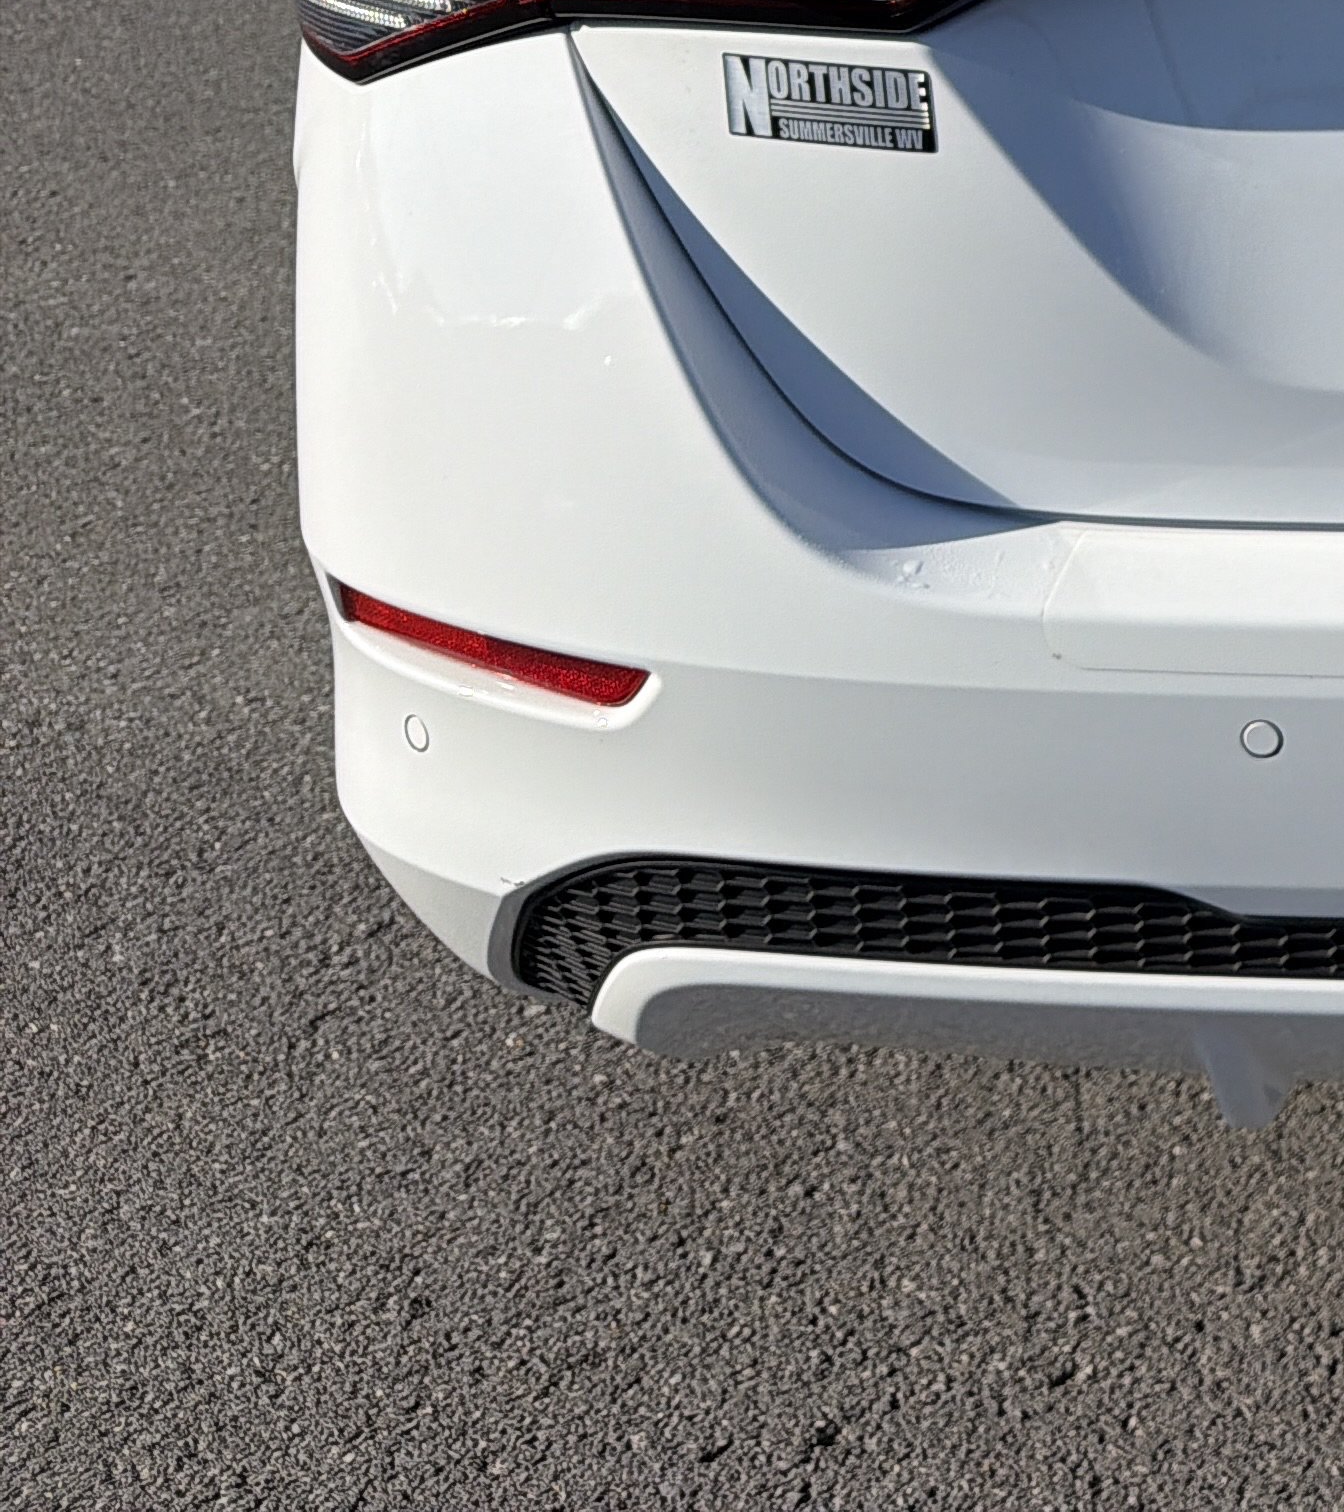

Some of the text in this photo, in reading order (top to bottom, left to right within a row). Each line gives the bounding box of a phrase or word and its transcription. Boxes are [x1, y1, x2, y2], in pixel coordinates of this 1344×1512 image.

[724, 55, 929, 137] NORTHSIDE
[778, 118, 924, 150] SUMMERSVILLE WV
